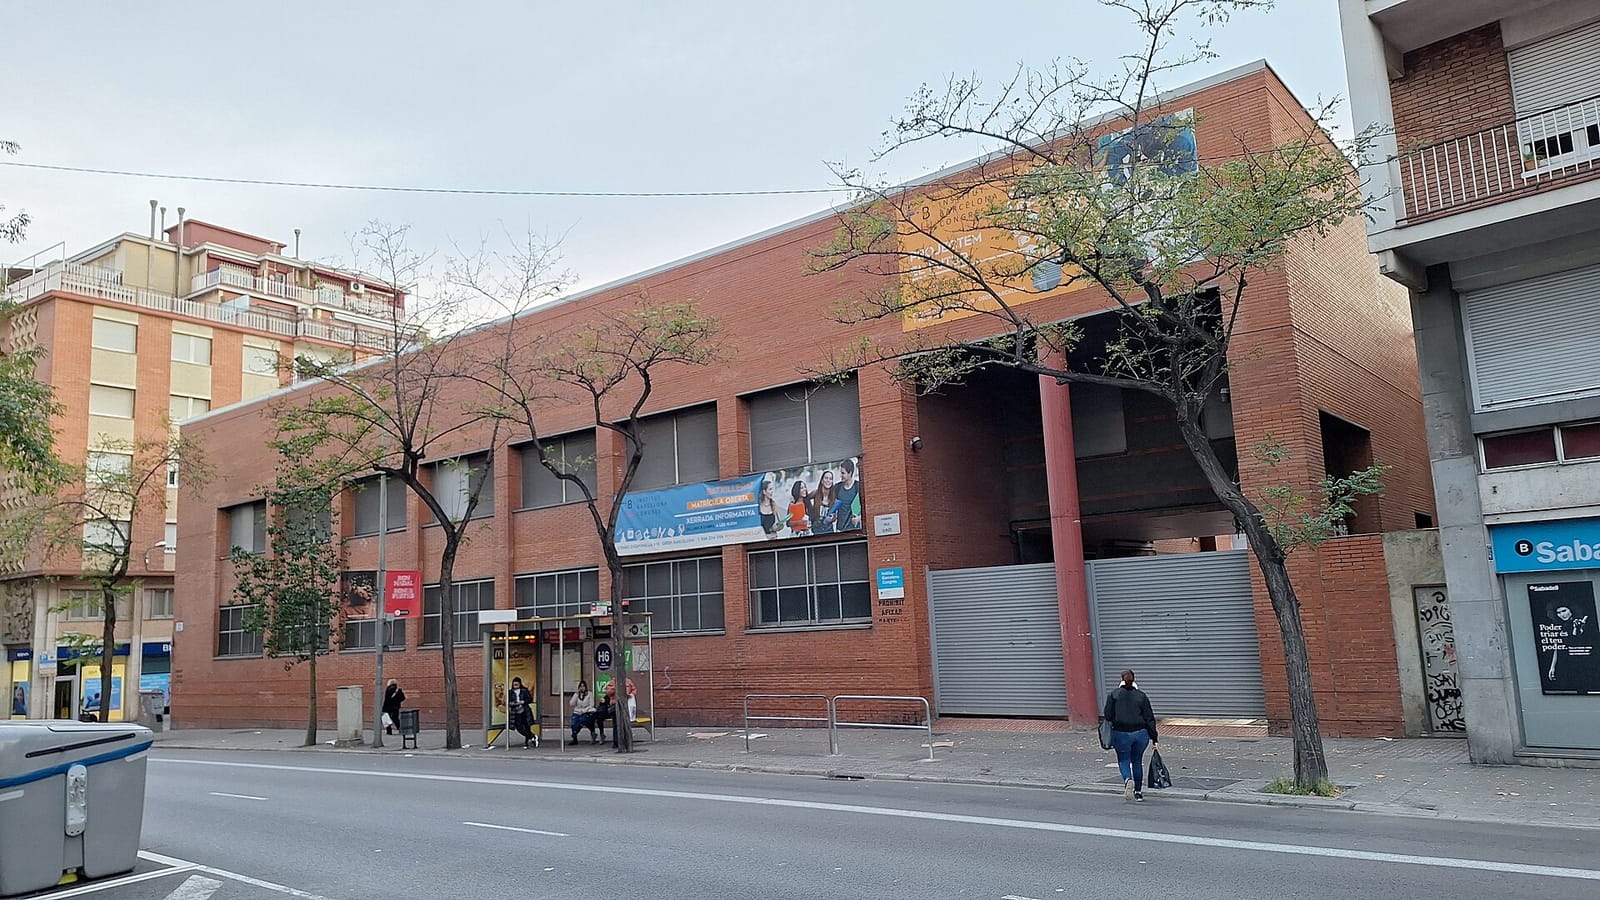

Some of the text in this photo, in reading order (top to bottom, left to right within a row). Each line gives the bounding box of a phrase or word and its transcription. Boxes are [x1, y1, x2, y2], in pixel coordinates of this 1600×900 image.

[686, 510, 756, 525] XERRADA INFORMATIVA
[1539, 623, 1562, 631] Poder
[1540, 630, 1558, 638] triar
[1542, 643, 1568, 652] poder.
[597, 651, 610, 662] H6
